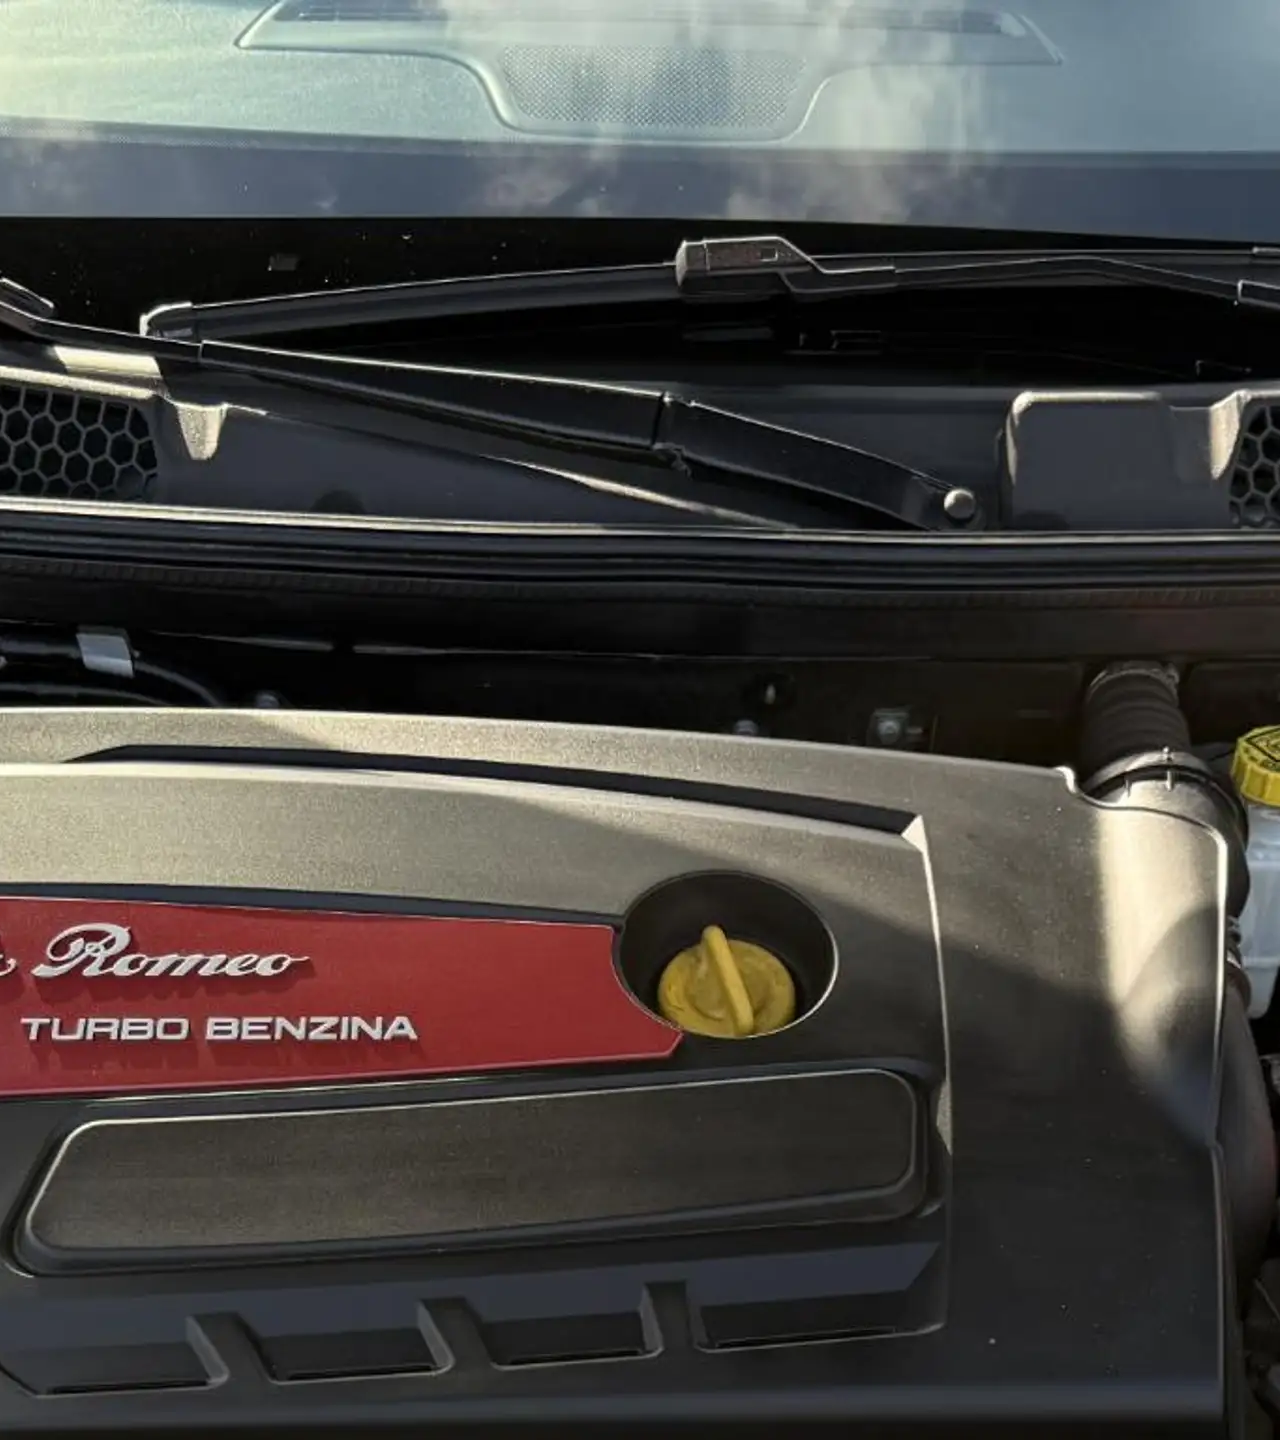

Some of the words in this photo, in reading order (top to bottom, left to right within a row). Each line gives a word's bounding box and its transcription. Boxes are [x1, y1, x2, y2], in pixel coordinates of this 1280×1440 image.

[32, 922, 310, 981] Romeo
[20, 1016, 191, 1043] TURBO
[205, 1015, 420, 1043] BENZINA
